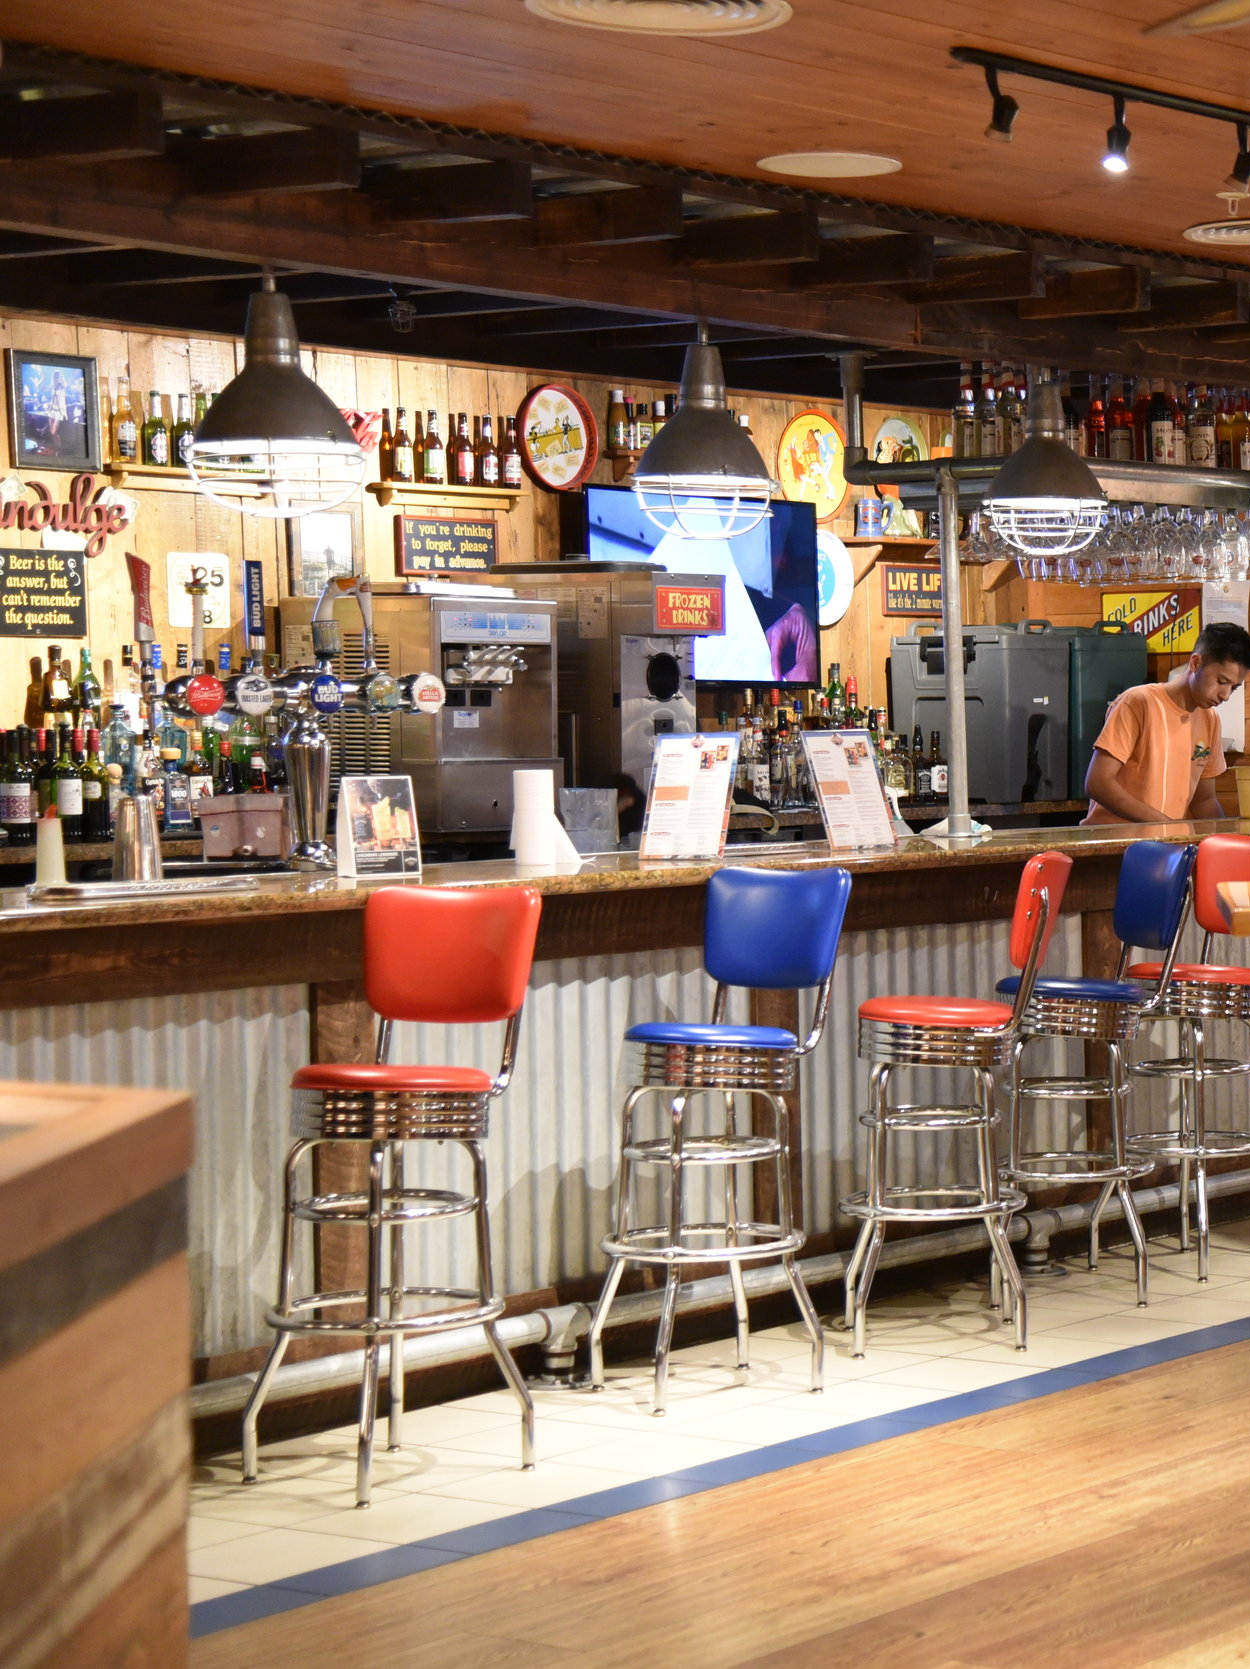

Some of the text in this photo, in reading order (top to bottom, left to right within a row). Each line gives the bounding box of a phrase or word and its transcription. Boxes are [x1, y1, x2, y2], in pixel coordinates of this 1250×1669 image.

[0, 473, 129, 557] ndulge
[405, 521, 492, 539] If you're drinking
[411, 538, 488, 554] to forget, please
[9, 555, 65, 571] Beer is the
[413, 555, 431, 569] pay
[434, 554, 445, 567] in
[6, 573, 68, 590] answer, but
[888, 572, 942, 592] LIVE LIF
[2, 590, 82, 607] can't remember
[250, 566, 262, 628] BUD LIGHT
[668, 592, 711, 609] FROZEN
[672, 609, 708, 625] DRINKS
[1107, 597, 1137, 623] COLD
[1133, 594, 1181, 636] RINKS
[5, 608, 74, 630] the question.
[1162, 612, 1193, 647] HERE
[315, 693, 343, 703] LIGHT
[316, 685, 338, 694] BUD
[171, 790, 187, 798] 1800
